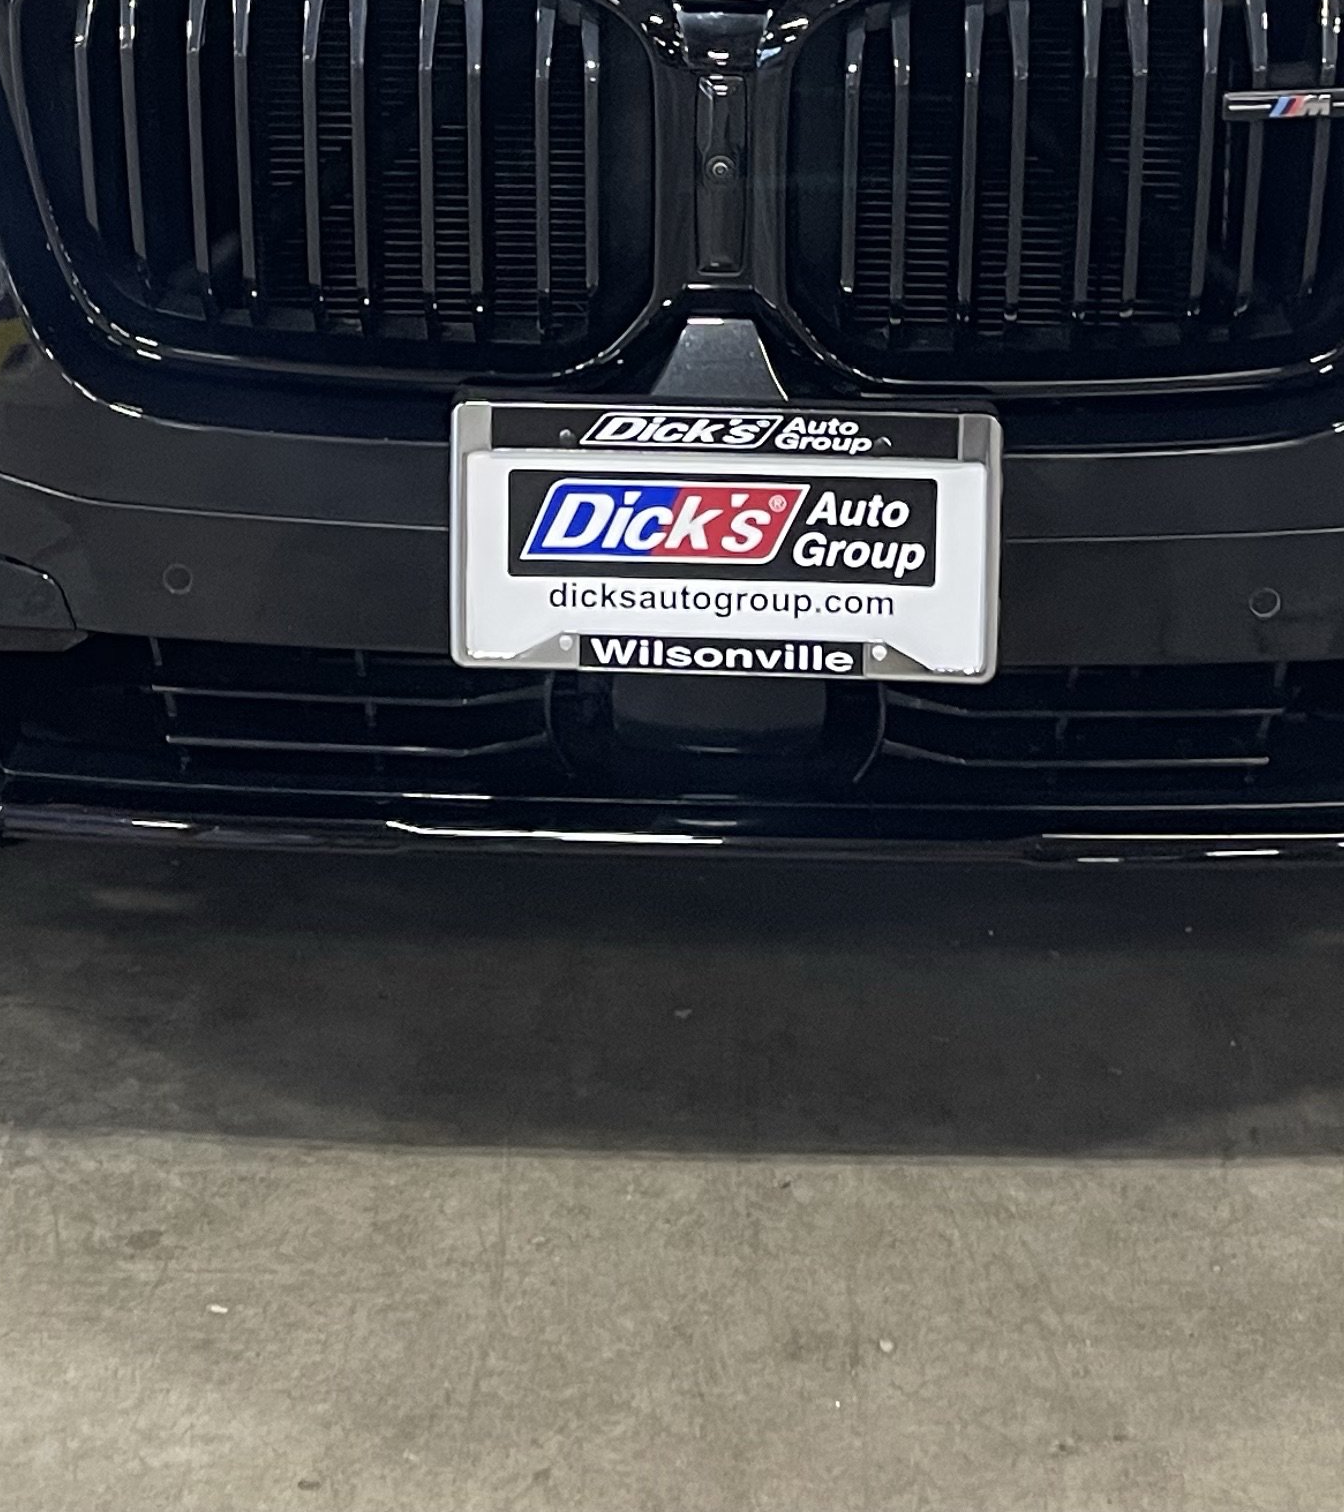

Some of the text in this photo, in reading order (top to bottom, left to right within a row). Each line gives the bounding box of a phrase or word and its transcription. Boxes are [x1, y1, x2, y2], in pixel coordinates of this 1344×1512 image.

[594, 415, 762, 444] Dick's
[774, 433, 873, 455] Group
[782, 416, 860, 435] Auto
[541, 490, 772, 554] Dick's
[806, 490, 910, 529] Auto
[792, 532, 927, 579] Group
[548, 581, 896, 619] dicksautogroup.com
[589, 636, 855, 673] Wilsonville
